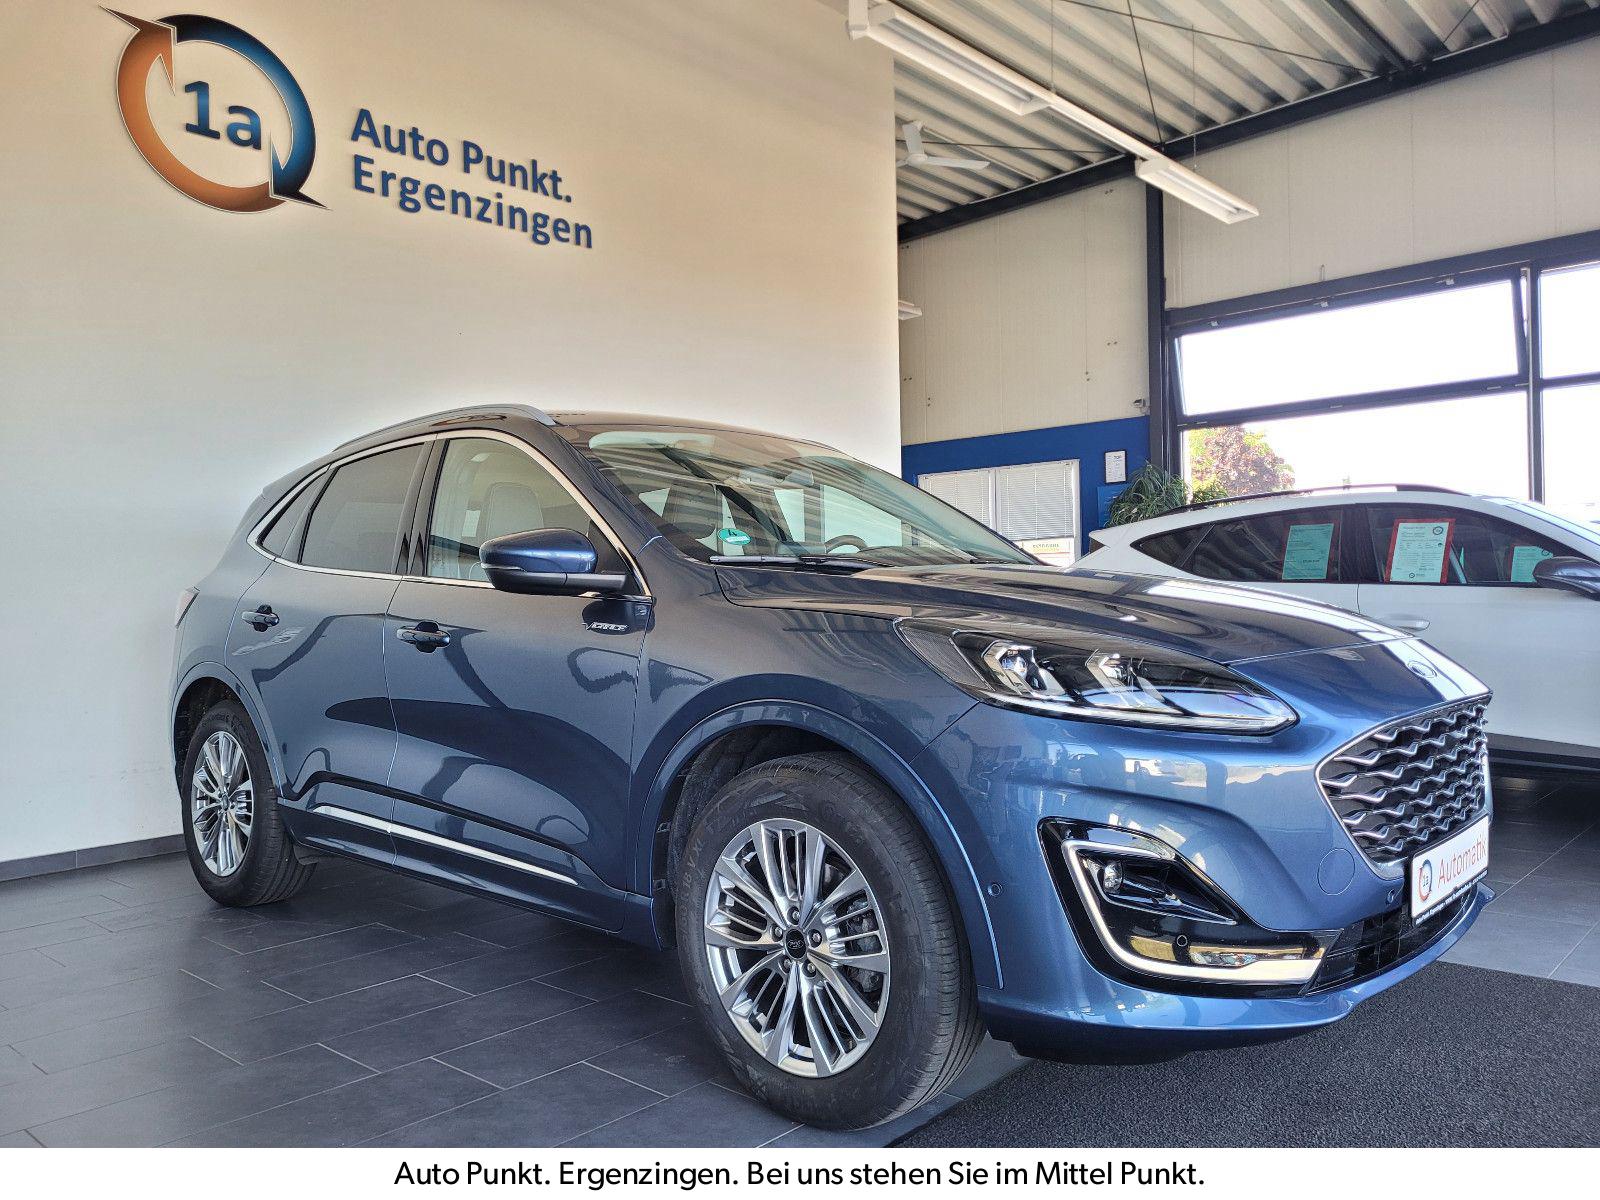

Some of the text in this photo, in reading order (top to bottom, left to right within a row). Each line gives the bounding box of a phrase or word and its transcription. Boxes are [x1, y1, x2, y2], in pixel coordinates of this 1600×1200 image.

[184, 80, 262, 150] 1a
[350, 108, 574, 203] Auto Punkt.
[353, 154, 594, 249] Ergenzingen
[1437, 833, 1487, 887] Automatik
